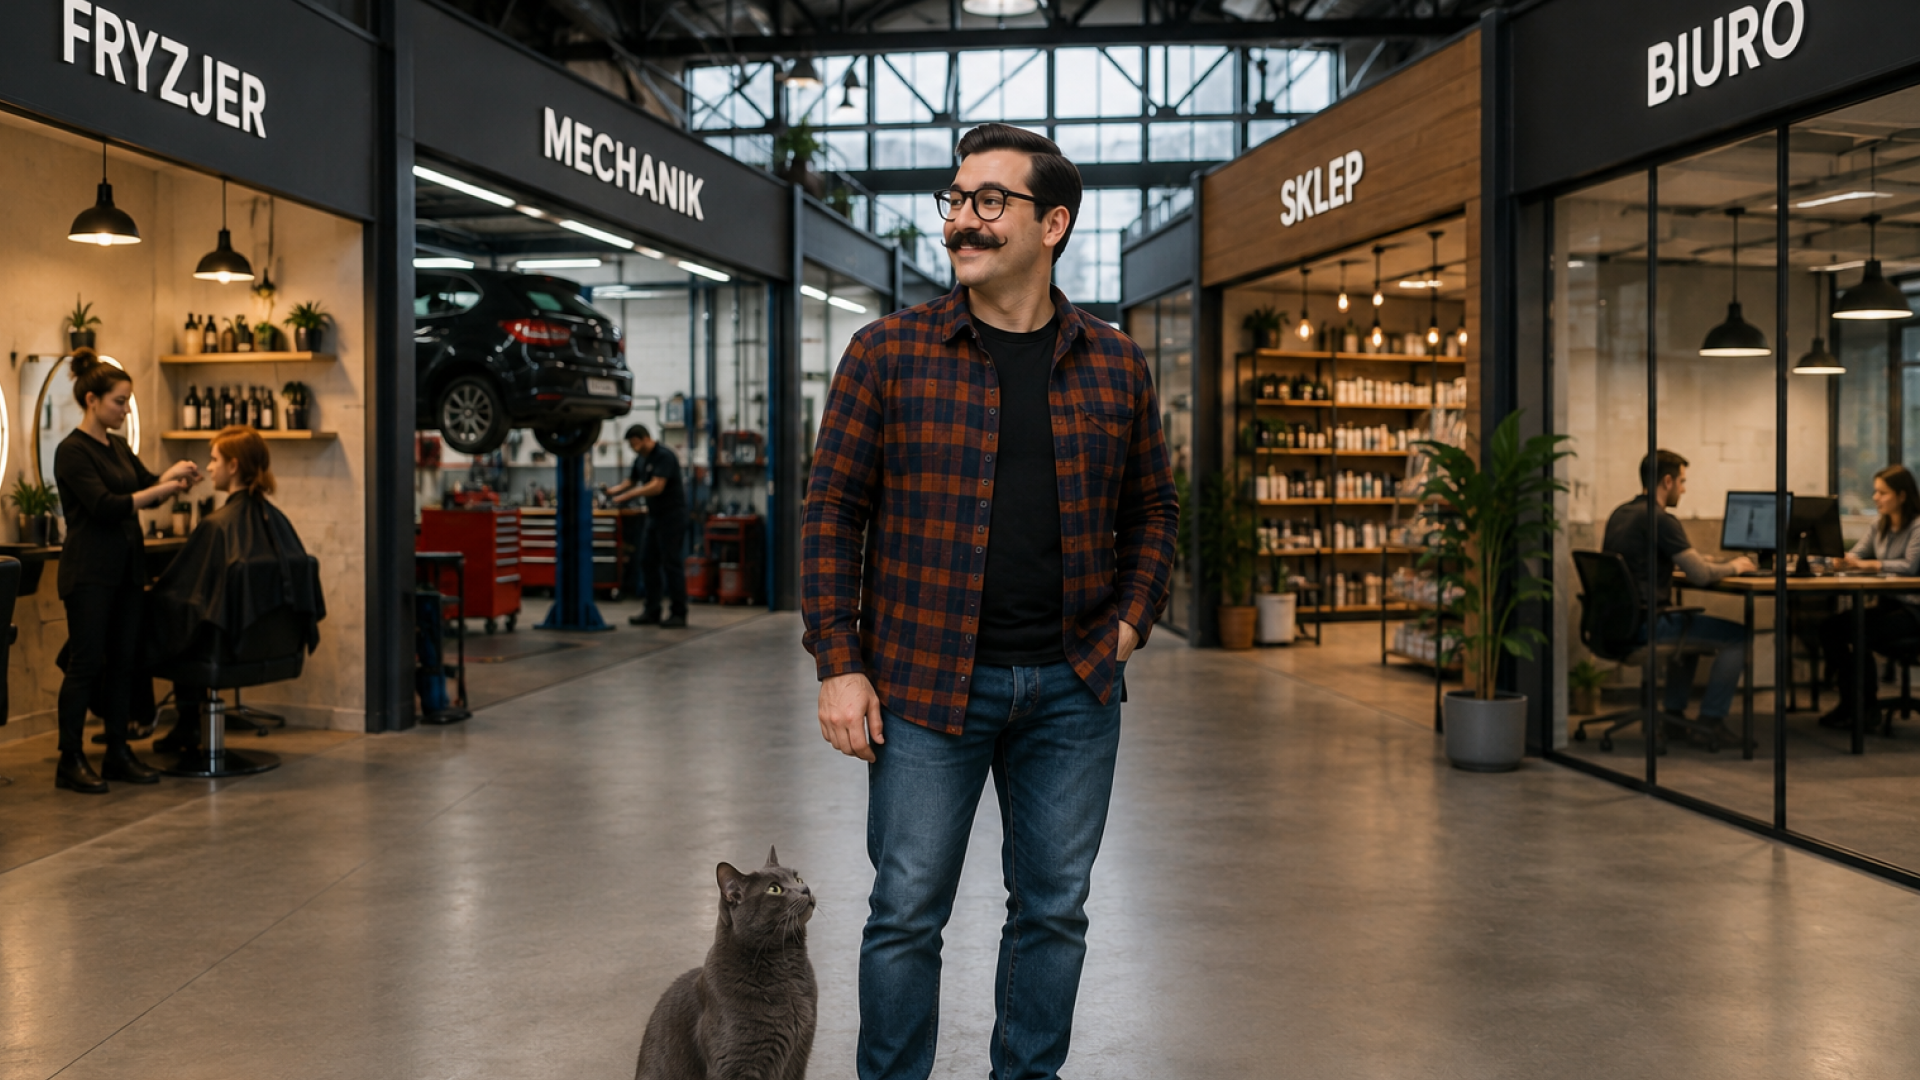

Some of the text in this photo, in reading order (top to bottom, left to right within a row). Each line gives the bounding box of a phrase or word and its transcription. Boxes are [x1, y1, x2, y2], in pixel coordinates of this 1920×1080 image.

[63, 0, 267, 138] FRYZJER
[1647, 0, 1806, 106] BIURO
[543, 107, 705, 221] MECHANIK
[1280, 150, 1364, 226] SKLEP
